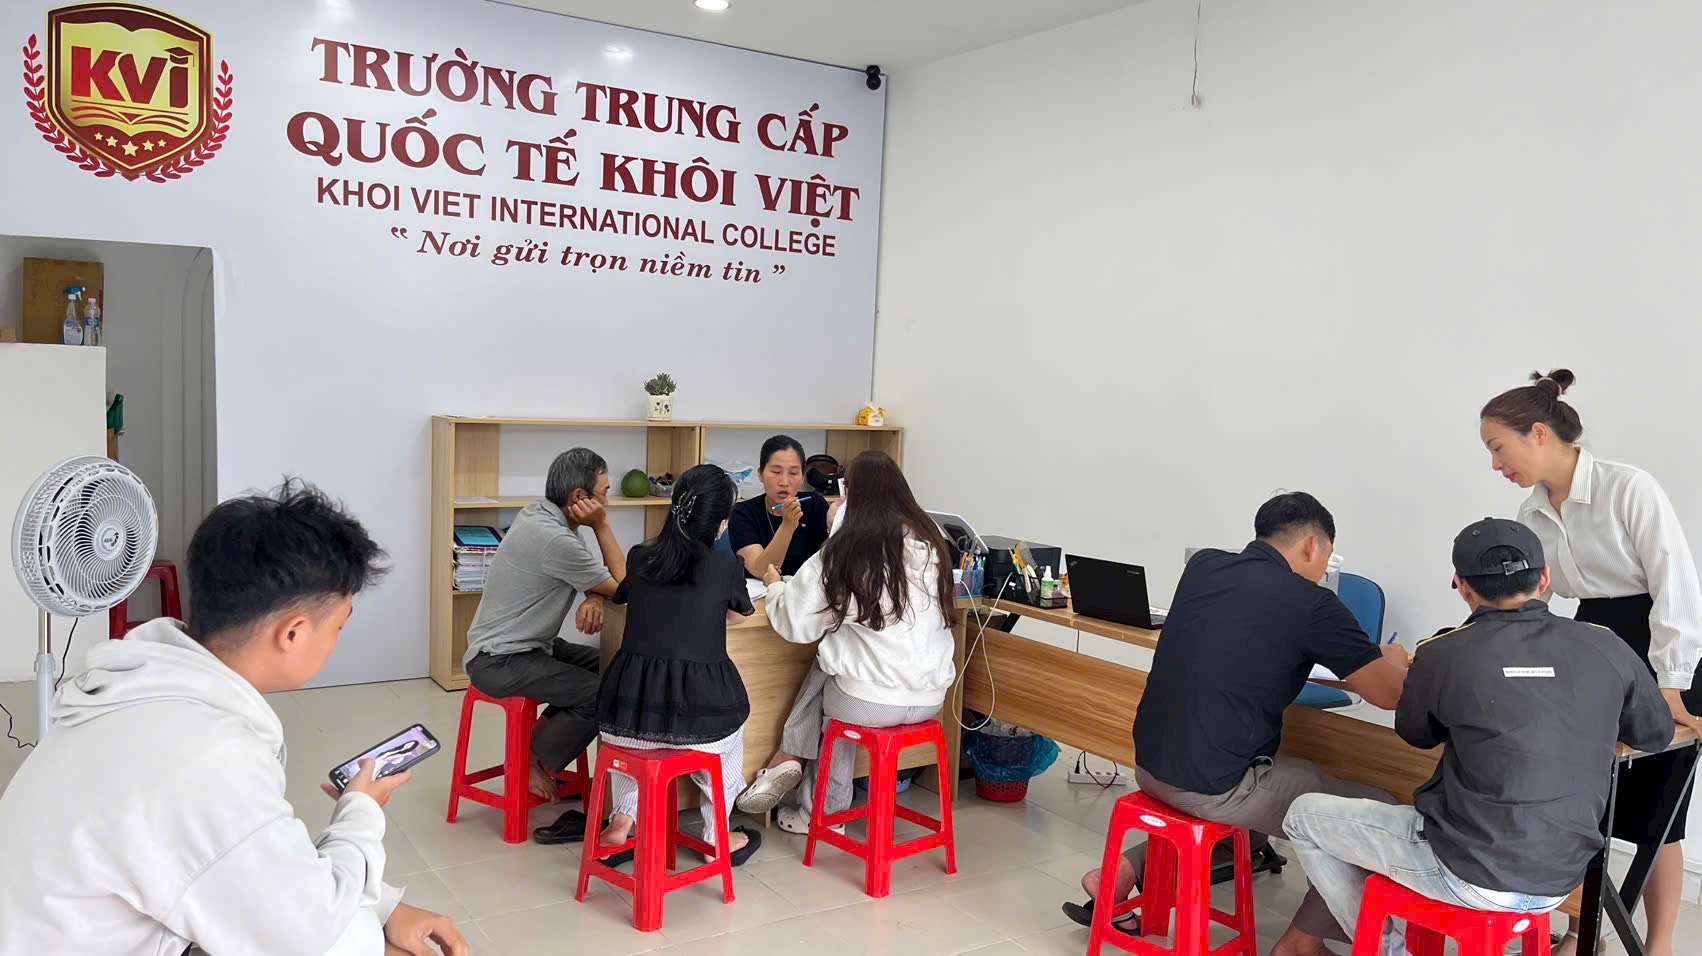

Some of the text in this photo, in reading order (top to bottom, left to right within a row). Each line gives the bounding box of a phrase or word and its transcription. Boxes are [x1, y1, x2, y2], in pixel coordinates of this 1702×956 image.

[311, 38, 850, 158] TRƯỜNG TRUNG CẤP
[287, 108, 861, 228] QUỐC TẾ KHÔI VIỆT
[317, 177, 836, 257] KHOI VIET INTERNATIONAL COLLEGE
[416, 230, 481, 257] Nơi
[491, 239, 549, 266] gửi
[560, 247, 629, 273] trọn
[639, 252, 713, 280] niềm
[722, 263, 761, 283] tin
